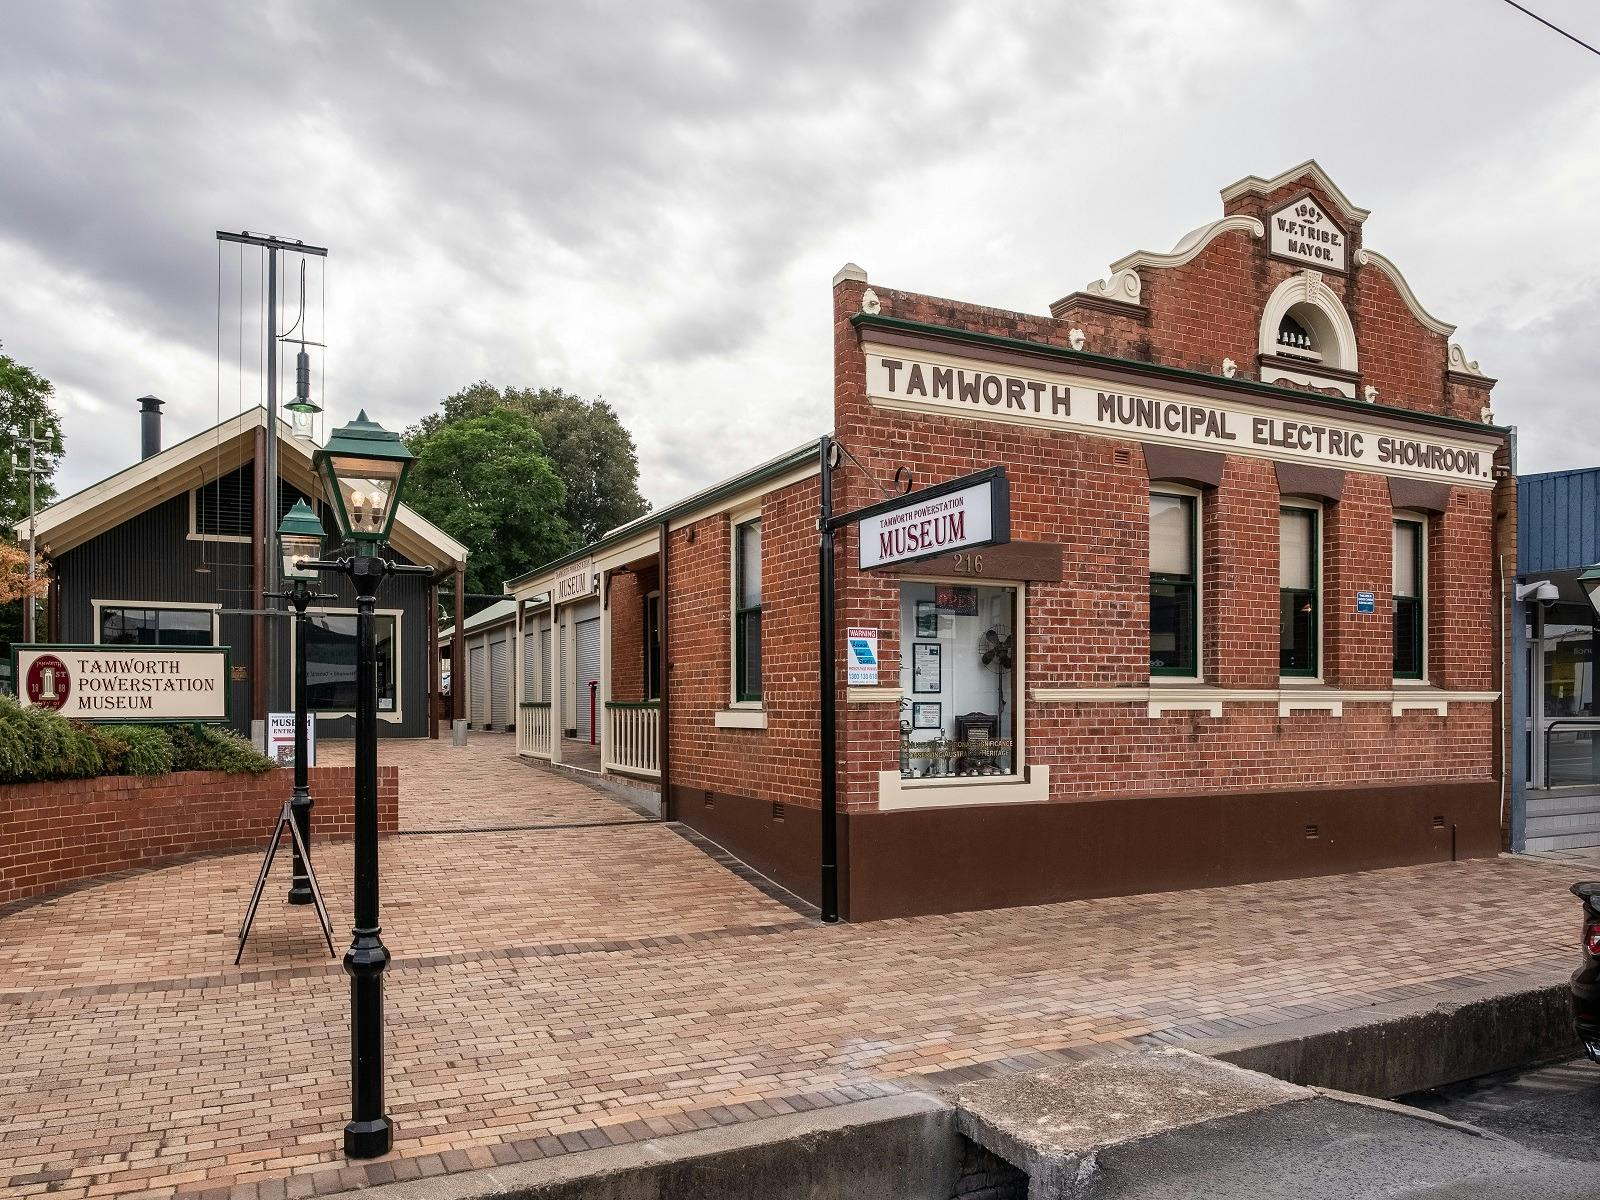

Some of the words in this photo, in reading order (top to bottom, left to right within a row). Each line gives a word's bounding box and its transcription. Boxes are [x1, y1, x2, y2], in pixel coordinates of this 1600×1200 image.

[1295, 204, 1323, 222] 1907
[1288, 239, 1334, 261] MAYOR.
[881, 358, 1071, 416] TAMWORTH
[1097, 392, 1236, 440] MUNICIPAL
[1252, 417, 1364, 458] ELECTRIC
[1377, 438, 1488, 478] SHOWROOM.
[880, 511, 913, 529] TAMWORTH
[914, 496, 964, 519] POWERSTATION
[879, 510, 967, 560] MUSEUM
[953, 553, 983, 573] 216
[559, 572, 586, 599] MUSEUM
[849, 629, 876, 638] WARNING
[77, 658, 180, 674] TAMWORTH
[78, 675, 214, 692] POWERSTATION
[78, 696, 153, 710] MUSEUM
[271, 718, 311, 727] MUSEM
